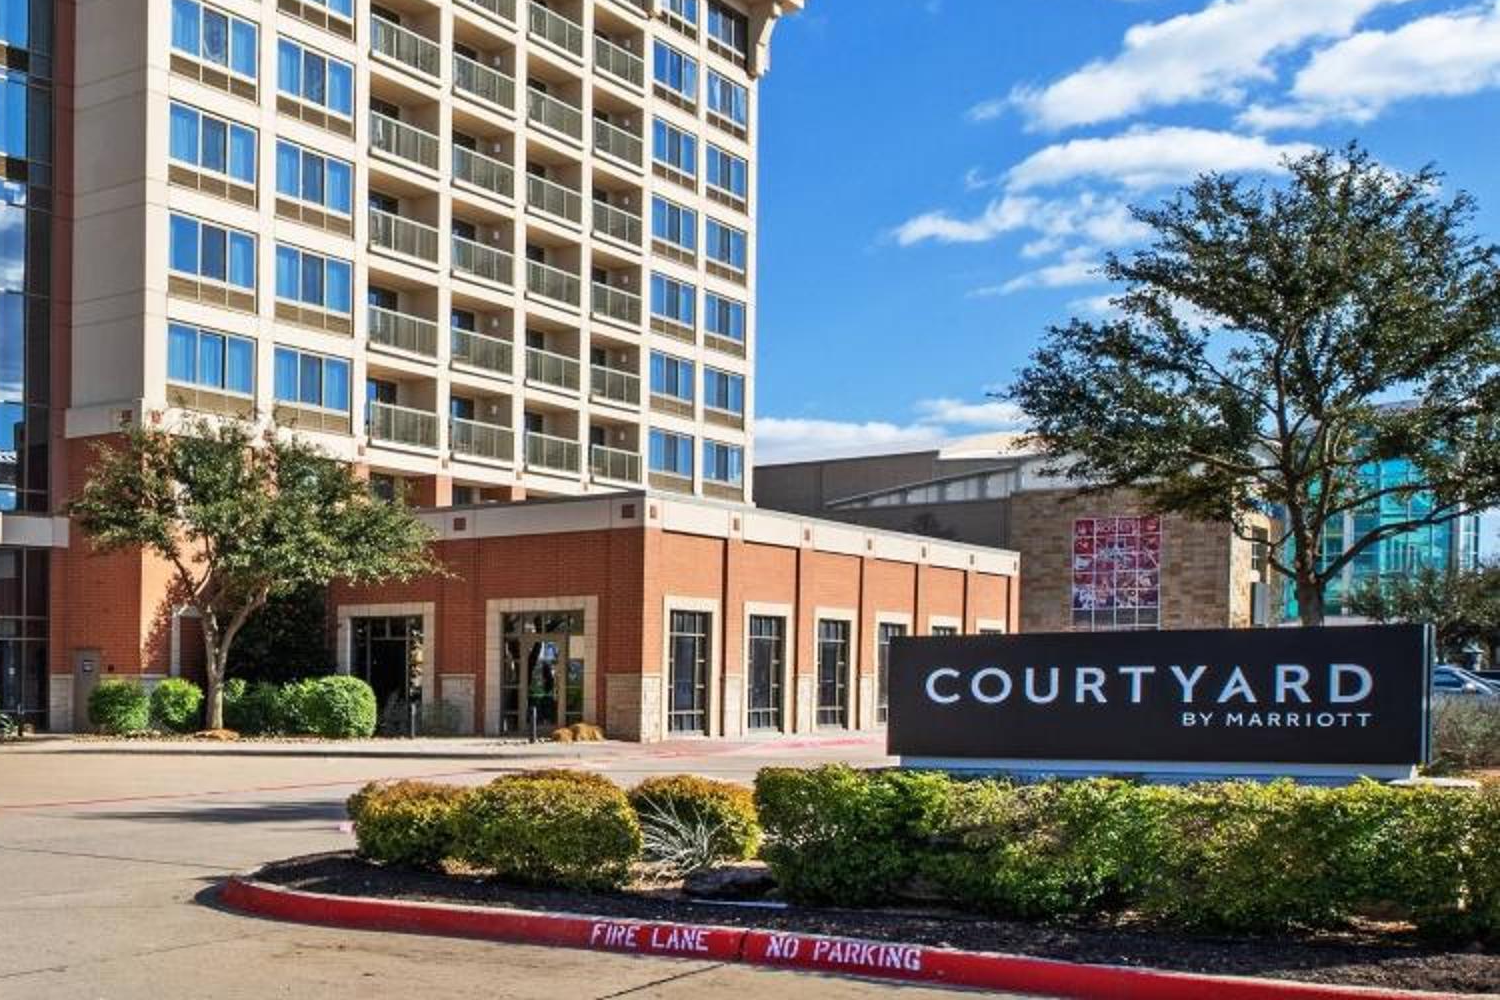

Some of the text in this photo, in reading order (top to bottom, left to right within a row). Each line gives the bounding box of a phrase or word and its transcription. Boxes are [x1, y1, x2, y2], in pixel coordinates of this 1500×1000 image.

[925, 663, 1373, 704] COURTYARD
[1182, 711, 1372, 728] BY MARRIOTT
[591, 922, 922, 970] FIRE LANE NO PARKING
